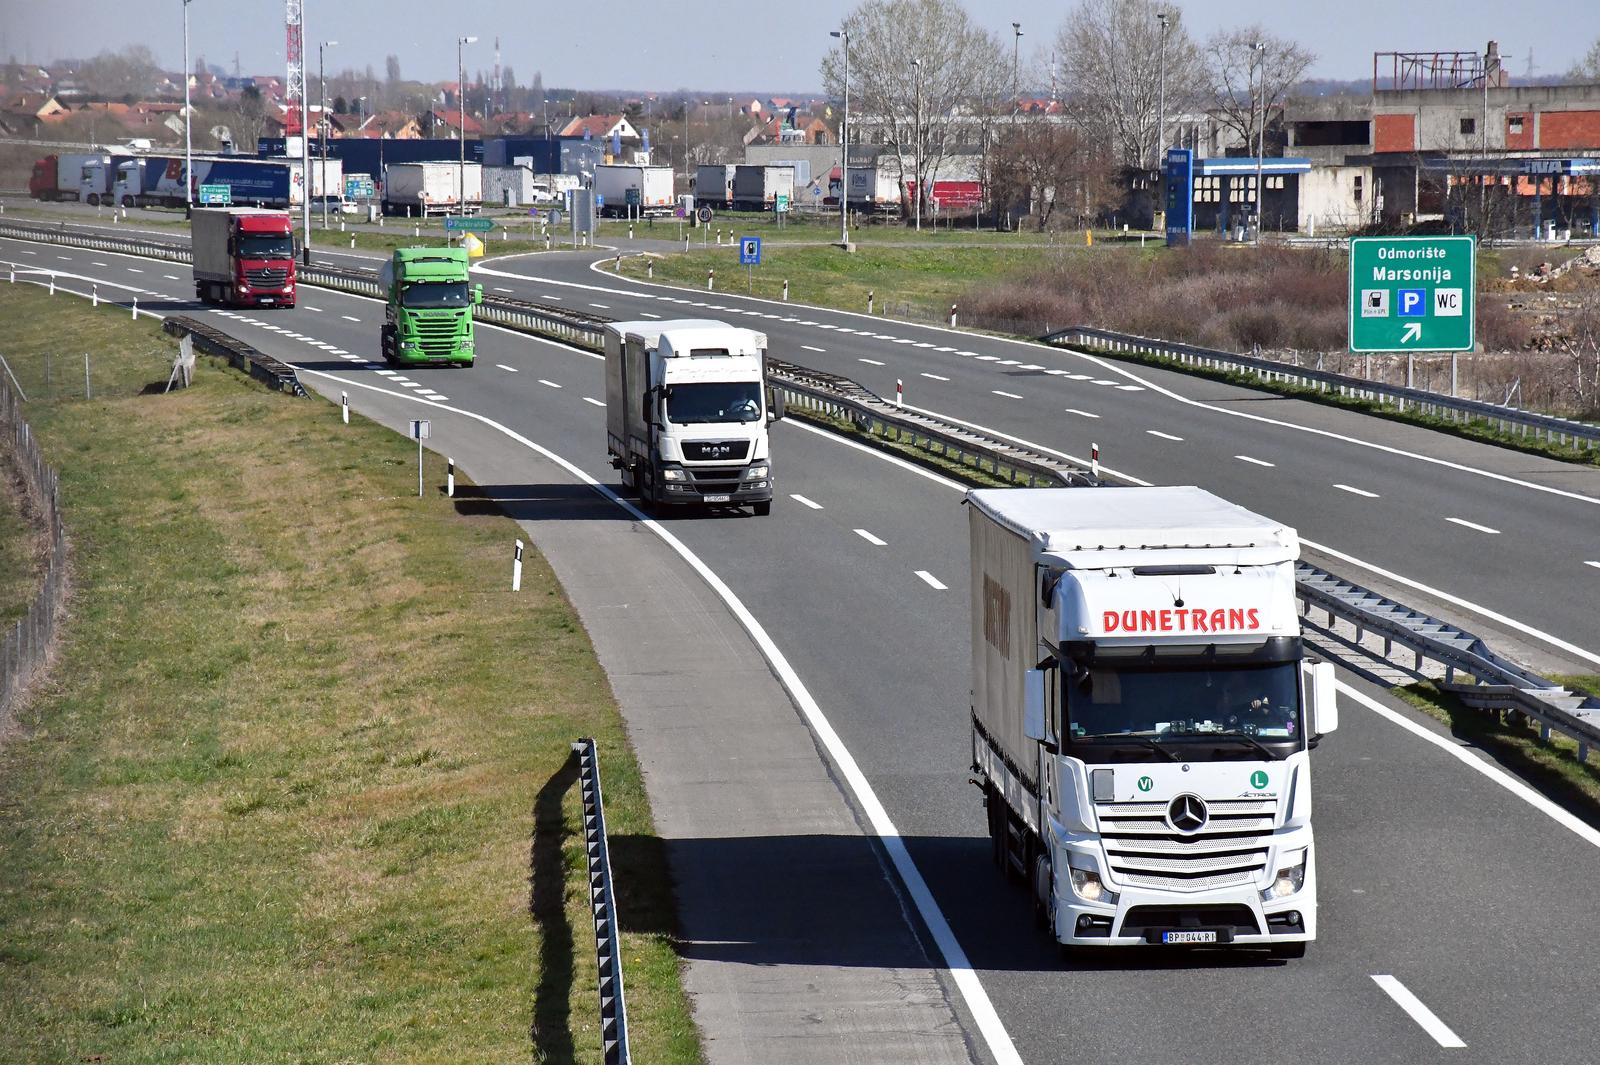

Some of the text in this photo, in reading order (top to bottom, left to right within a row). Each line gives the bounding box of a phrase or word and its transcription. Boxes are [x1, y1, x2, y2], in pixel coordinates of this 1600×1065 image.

[700, 210, 709, 219] 40
[1378, 247, 1447, 260] Odmorište
[1373, 266, 1452, 284] Marsonija
[1404, 292, 1419, 313] P
[1437, 294, 1457, 309] WC
[1103, 608, 1260, 633] DUNETRANS
[1140, 778, 1152, 790] VI
[1255, 773, 1264, 786] L
[1169, 933, 1180, 942] BP
